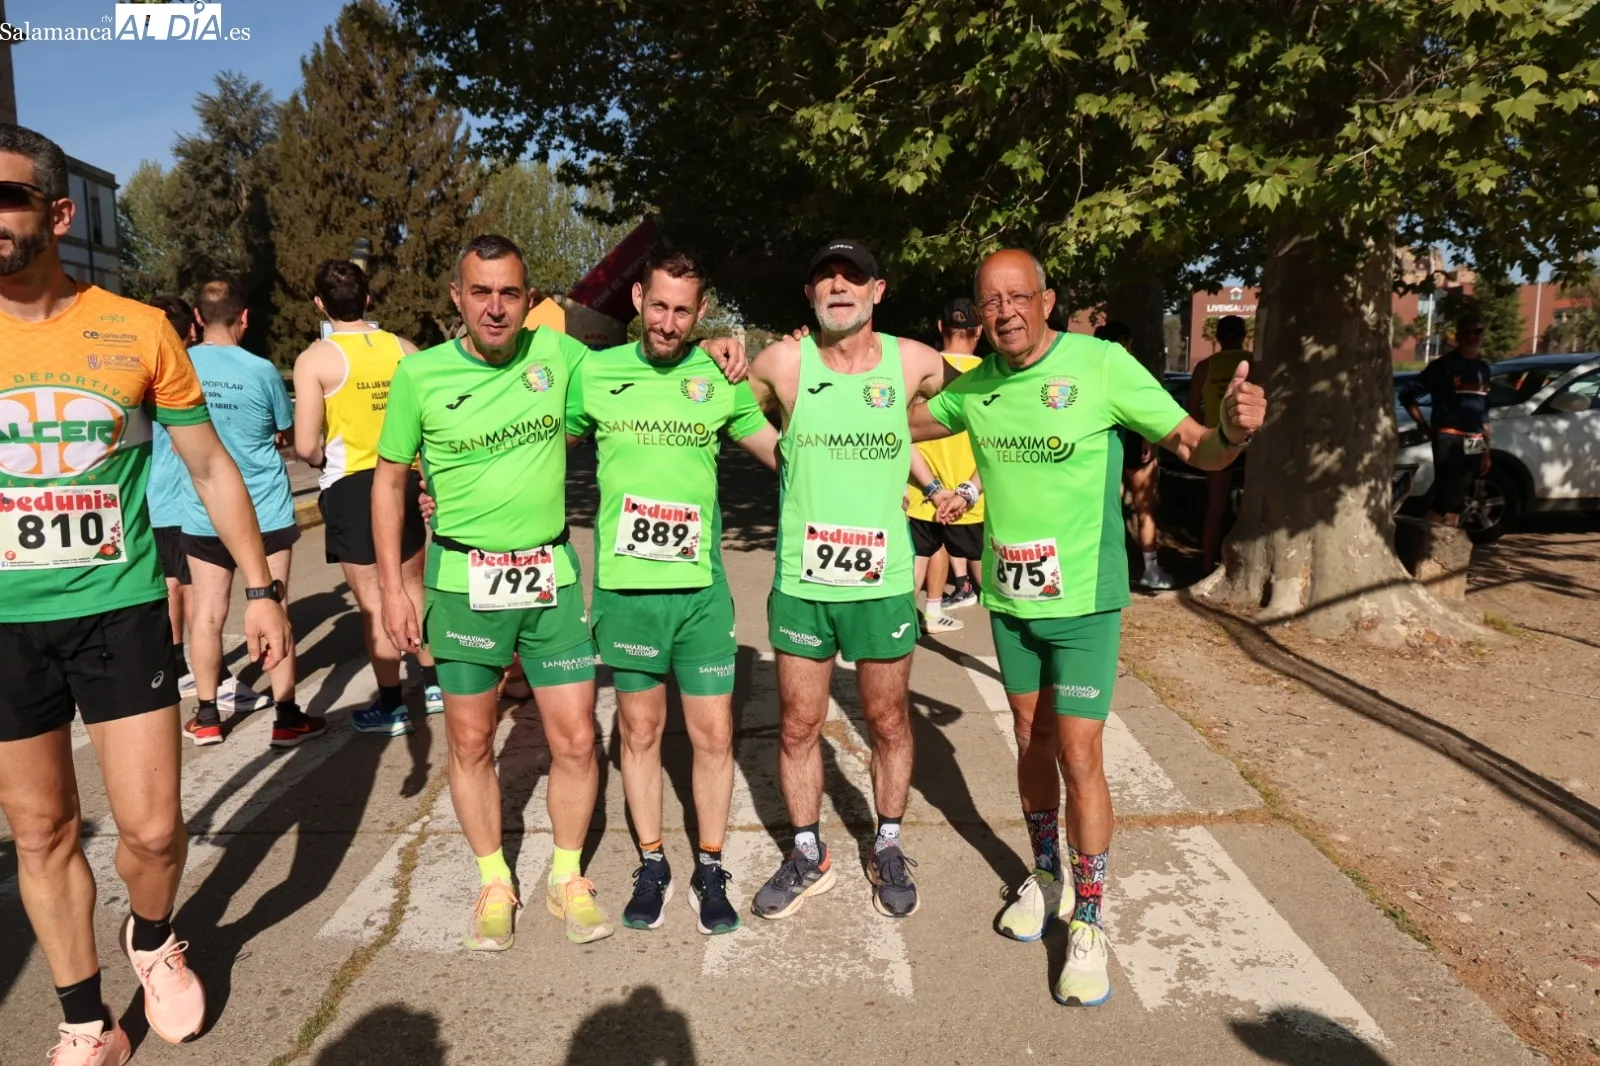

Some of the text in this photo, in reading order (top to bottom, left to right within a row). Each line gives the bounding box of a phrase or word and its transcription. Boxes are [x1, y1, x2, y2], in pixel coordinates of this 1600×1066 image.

[13, 372, 132, 405] DEPORTIVO
[202, 380, 243, 391] POPULAR
[449, 414, 554, 454] SANMAXIMO
[604, 419, 706, 434] SANMAXIMO
[487, 430, 548, 455] TELECOM
[634, 432, 699, 447] TELECOM
[797, 432, 896, 447] SANMAXIMO
[828, 447, 890, 460] TELECOM
[995, 450, 1052, 463] TELECOM
[0, 489, 118, 512] bedunia
[624, 497, 699, 522] bedunia
[17, 511, 104, 550] 810
[632, 517, 689, 547] 889
[816, 543, 873, 573] 948
[484, 566, 542, 596] 792
[997, 557, 1046, 590] 875
